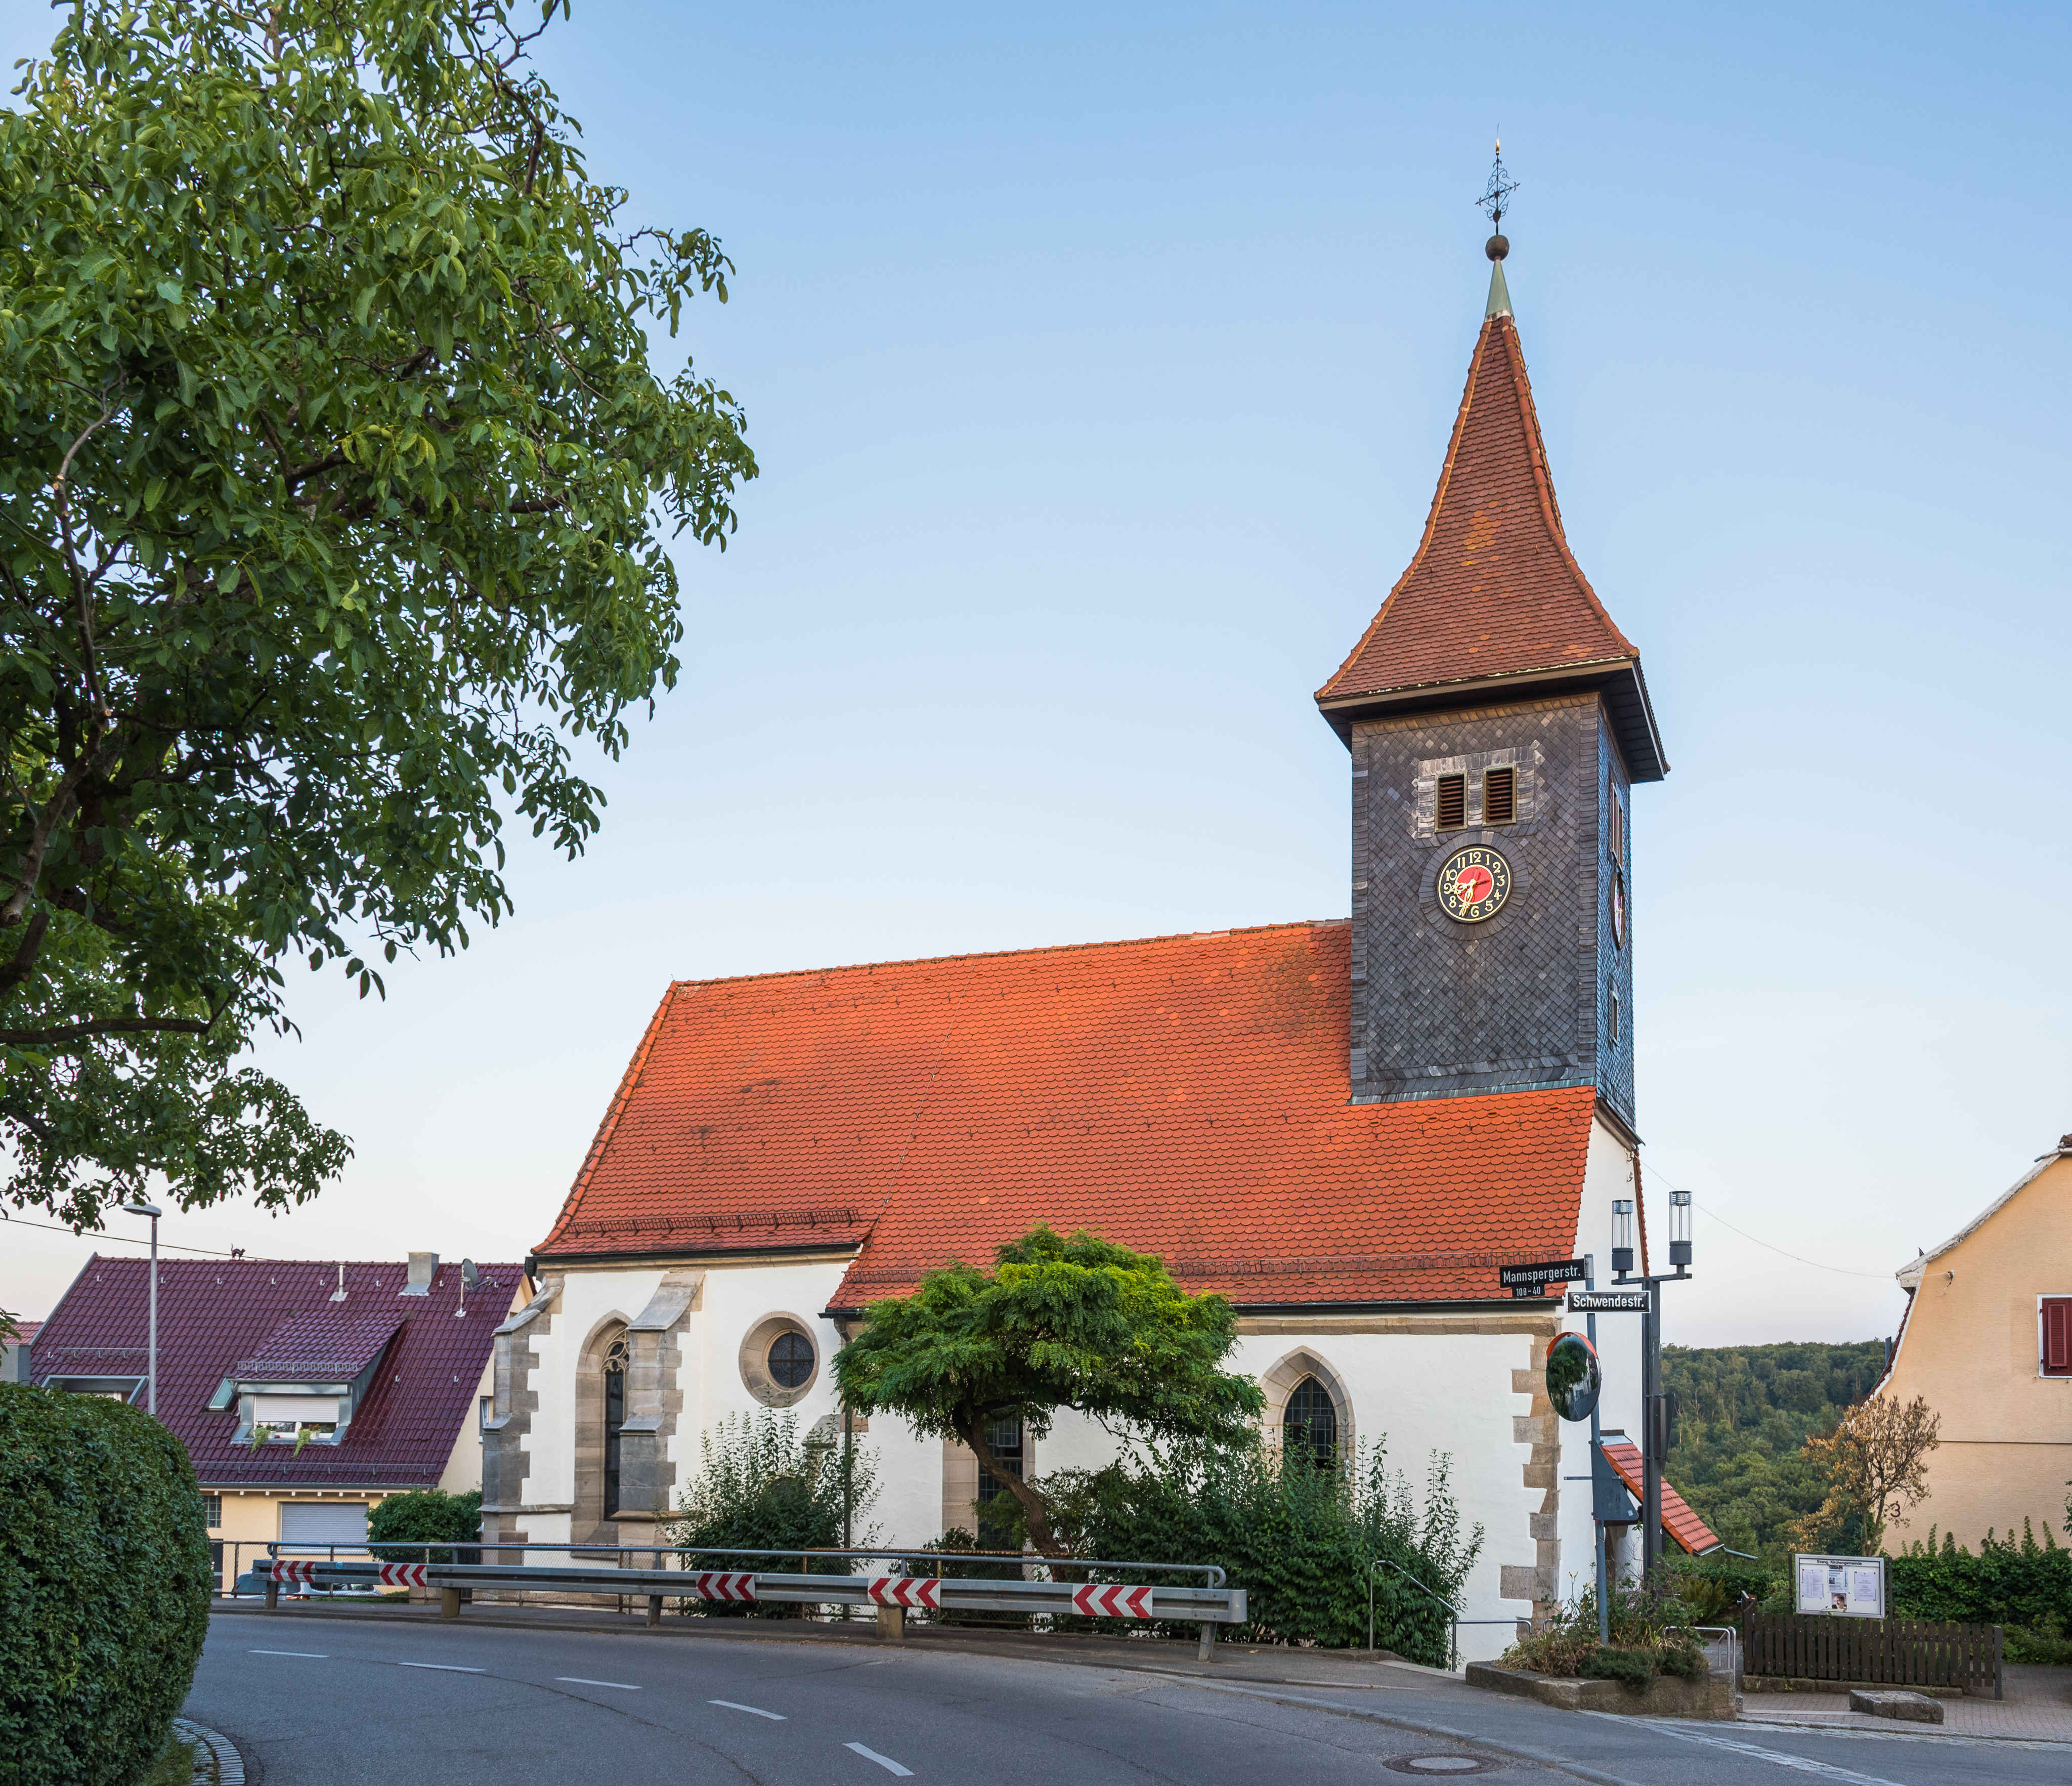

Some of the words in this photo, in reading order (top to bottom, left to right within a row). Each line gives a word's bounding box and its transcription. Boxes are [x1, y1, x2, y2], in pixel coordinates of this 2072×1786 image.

[1457, 857, 1465, 869] 11
[1469, 851, 1481, 864] 12
[1486, 854, 1490, 866] 1
[1492, 861, 1501, 874] 2
[1446, 869, 1457, 881] 10
[1496, 874, 1505, 886] 3
[1443, 882, 1452, 895] 9
[1493, 888, 1502, 900] 4
[1449, 895, 1457, 908] 8
[1484, 900, 1493, 912] 5
[1470, 905, 1480, 917] 6
[1503, 1265, 1580, 1283] Mannspergerstr.
[1573, 1295, 1644, 1307] Schwendestr.
[1890, 1503, 1901, 1517] 3
